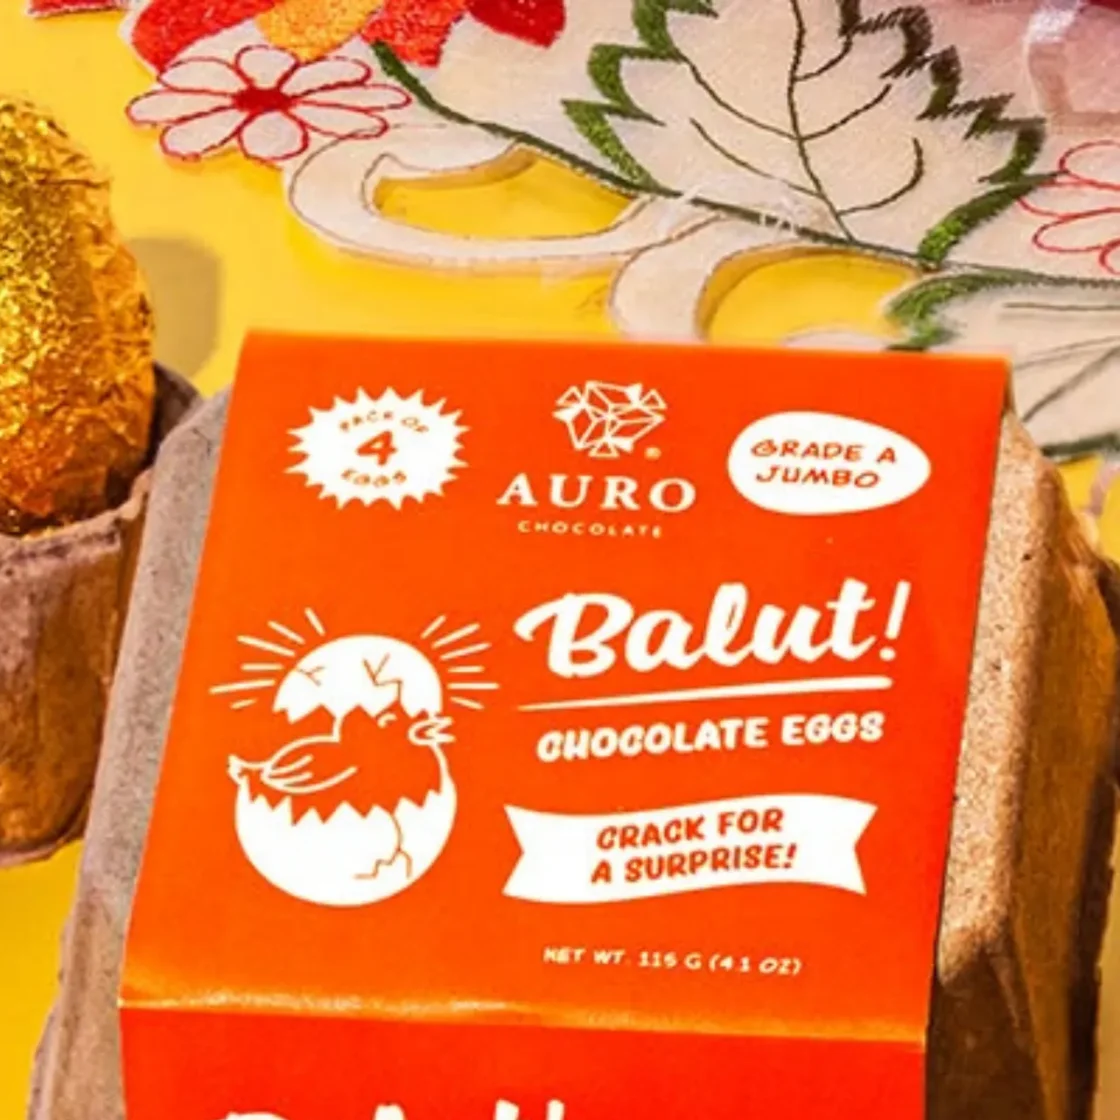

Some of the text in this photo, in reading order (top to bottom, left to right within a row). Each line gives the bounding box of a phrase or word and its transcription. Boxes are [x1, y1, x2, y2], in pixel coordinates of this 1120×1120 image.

[355, 430, 398, 466] 4
[750, 439, 897, 464] GRADE A
[496, 472, 696, 513] AURO
[755, 465, 880, 488] JUMBO
[517, 520, 663, 539] CHOCOLATE
[513, 577, 911, 679] Balut!
[536, 711, 886, 763] CHOCOLATE EGGS
[596, 808, 785, 851] CRACK FOR
[590, 843, 798, 885] A SURPRISE!
[543, 946, 585, 965] NET
[683, 953, 703, 971] G
[709, 953, 751, 973] (41
[758, 956, 802, 976] OZ)
